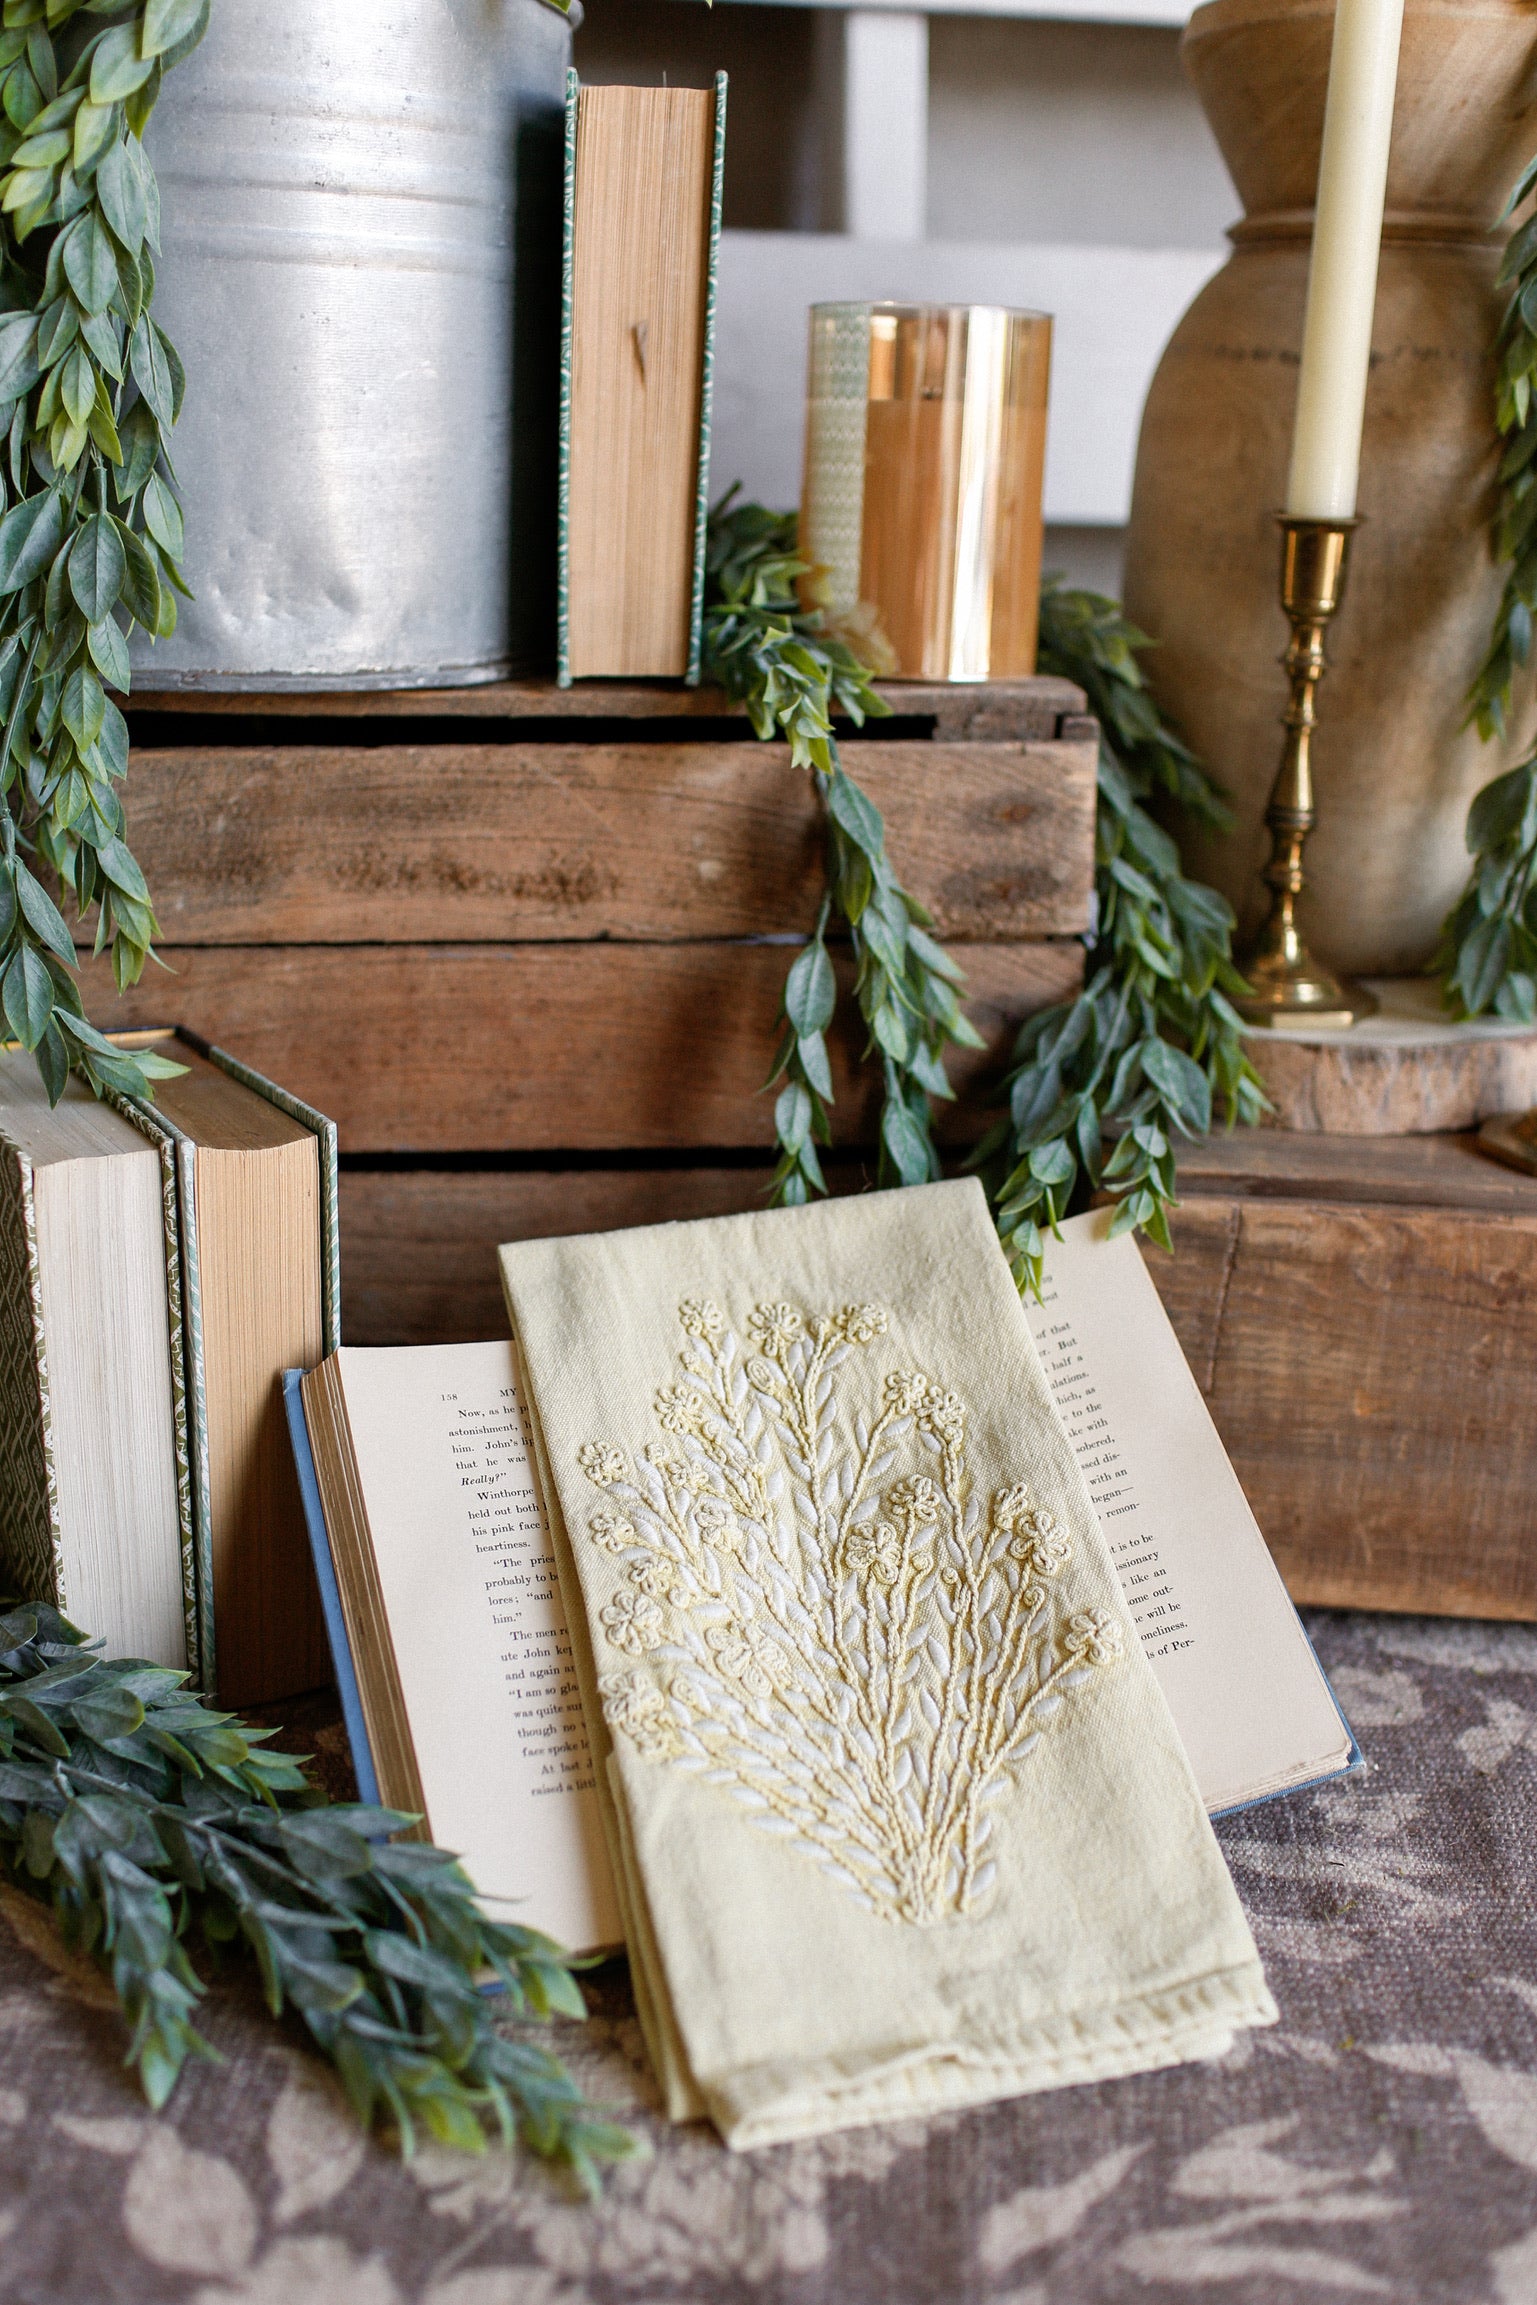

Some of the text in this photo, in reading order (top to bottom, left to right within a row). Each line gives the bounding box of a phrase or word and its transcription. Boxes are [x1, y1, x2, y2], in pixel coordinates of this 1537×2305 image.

[1036, 1322, 1070, 1339] of that
[1058, 1338, 1077, 1350] But
[1051, 1356, 1071, 1371] half
[440, 1388, 516, 1401] 158 MY
[1085, 1387, 1095, 1395] as
[458, 1409, 485, 1418] Now,
[503, 1406, 515, 1414] he
[1072, 1410, 1082, 1418] to
[1086, 1403, 1102, 1413] the
[448, 1423, 518, 1437] astonishment,
[1087, 1418, 1108, 1431] with
[452, 1445, 474, 1453] him.
[1075, 1434, 1115, 1453] sobered,
[456, 1455, 526, 1469] that he was
[1103, 1452, 1120, 1463] dis-
[1089, 1469, 1128, 1485] with an
[477, 1488, 534, 1500] Winthorpe
[468, 1509, 490, 1519] held
[494, 1507, 512, 1516] out
[516, 1503, 540, 1513] both
[1106, 1503, 1140, 1518] remon-
[472, 1527, 487, 1536] his
[491, 1523, 515, 1536] pink
[519, 1522, 541, 1531] face
[475, 1541, 531, 1553] heartiness.
[1118, 1542, 1127, 1551] is
[1129, 1539, 1140, 1547] to
[1141, 1534, 1153, 1543] be
[485, 1575, 531, 1590] probably
[536, 1574, 547, 1582] to
[1130, 1574, 1149, 1585] like
[1153, 1568, 1166, 1577] an
[488, 1596, 519, 1605] lores;
[1127, 1586, 1173, 1606] ome out-
[1147, 1606, 1166, 1619] will
[1168, 1603, 1181, 1612] be
[510, 1630, 532, 1640] The
[536, 1629, 556, 1638] men
[501, 1652, 518, 1662] ute
[523, 1648, 550, 1659] John
[1158, 1644, 1168, 1656] of
[1171, 1640, 1195, 1651] Per-
[505, 1669, 525, 1680] and
[530, 1665, 560, 1679] again
[545, 1687, 556, 1695] so
[514, 1710, 533, 1718] was
[536, 1704, 563, 1718] quite
[518, 1724, 556, 1738] though
[563, 1724, 576, 1732] no
[522, 1747, 545, 1757] face
[548, 1741, 578, 1756] spoke
[541, 1765, 554, 1775] At
[561, 1761, 579, 1772] last
